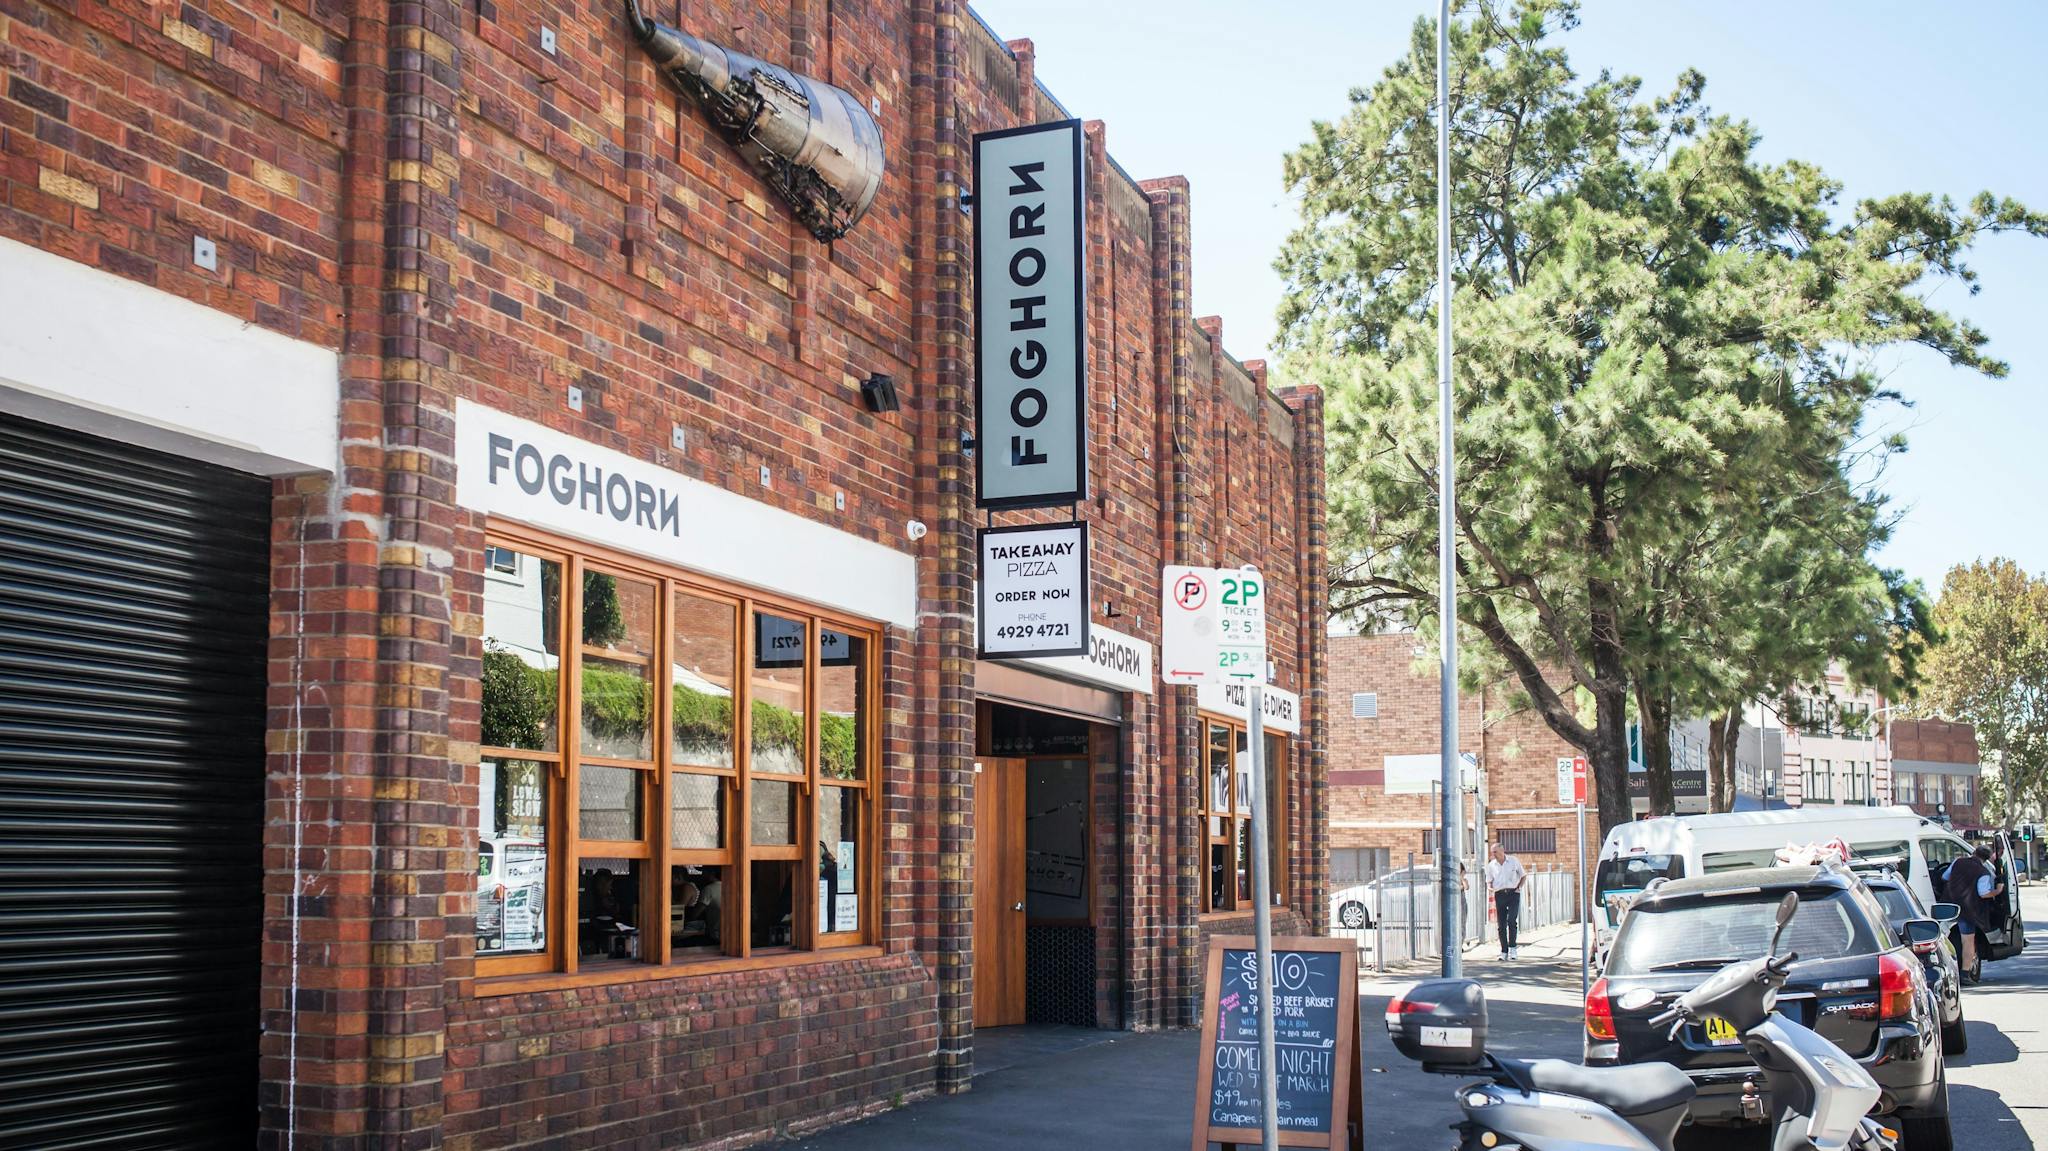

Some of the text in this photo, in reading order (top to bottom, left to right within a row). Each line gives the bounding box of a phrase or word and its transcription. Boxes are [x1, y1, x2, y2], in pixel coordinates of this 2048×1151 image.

[990, 543, 1075, 559] TAKEAWAY
[1007, 561, 1058, 578] PIZZA
[995, 588, 1070, 603] ORDER NOW
[1221, 578, 1259, 606] 2P
[1018, 612, 1047, 622] PHONE
[1224, 606, 1258, 616] TICKET
[997, 623, 1070, 639] 4929 4721
[1081, 634, 1141, 677] OGHORN
[1219, 652, 1240, 668] 2P
[1225, 684, 1247, 707] PIZZ
[1559, 761, 1572, 772] 2P
[1676, 778, 1702, 787] Centre
[512, 800, 542, 817] SLOW
[1284, 995, 1303, 1007] BEEF
[1305, 996, 1335, 1008] BRISKET
[1826, 1001, 1876, 1013] OUTBACK
[1284, 1006, 1305, 1018] PORK
[1216, 1046, 1331, 1076] COME NIGHT
[1218, 1072, 1243, 1088] WED
[1287, 1074, 1330, 1093] MARCH
[1212, 1108, 1257, 1125] Canapes
[1295, 1116, 1319, 1127] meal
